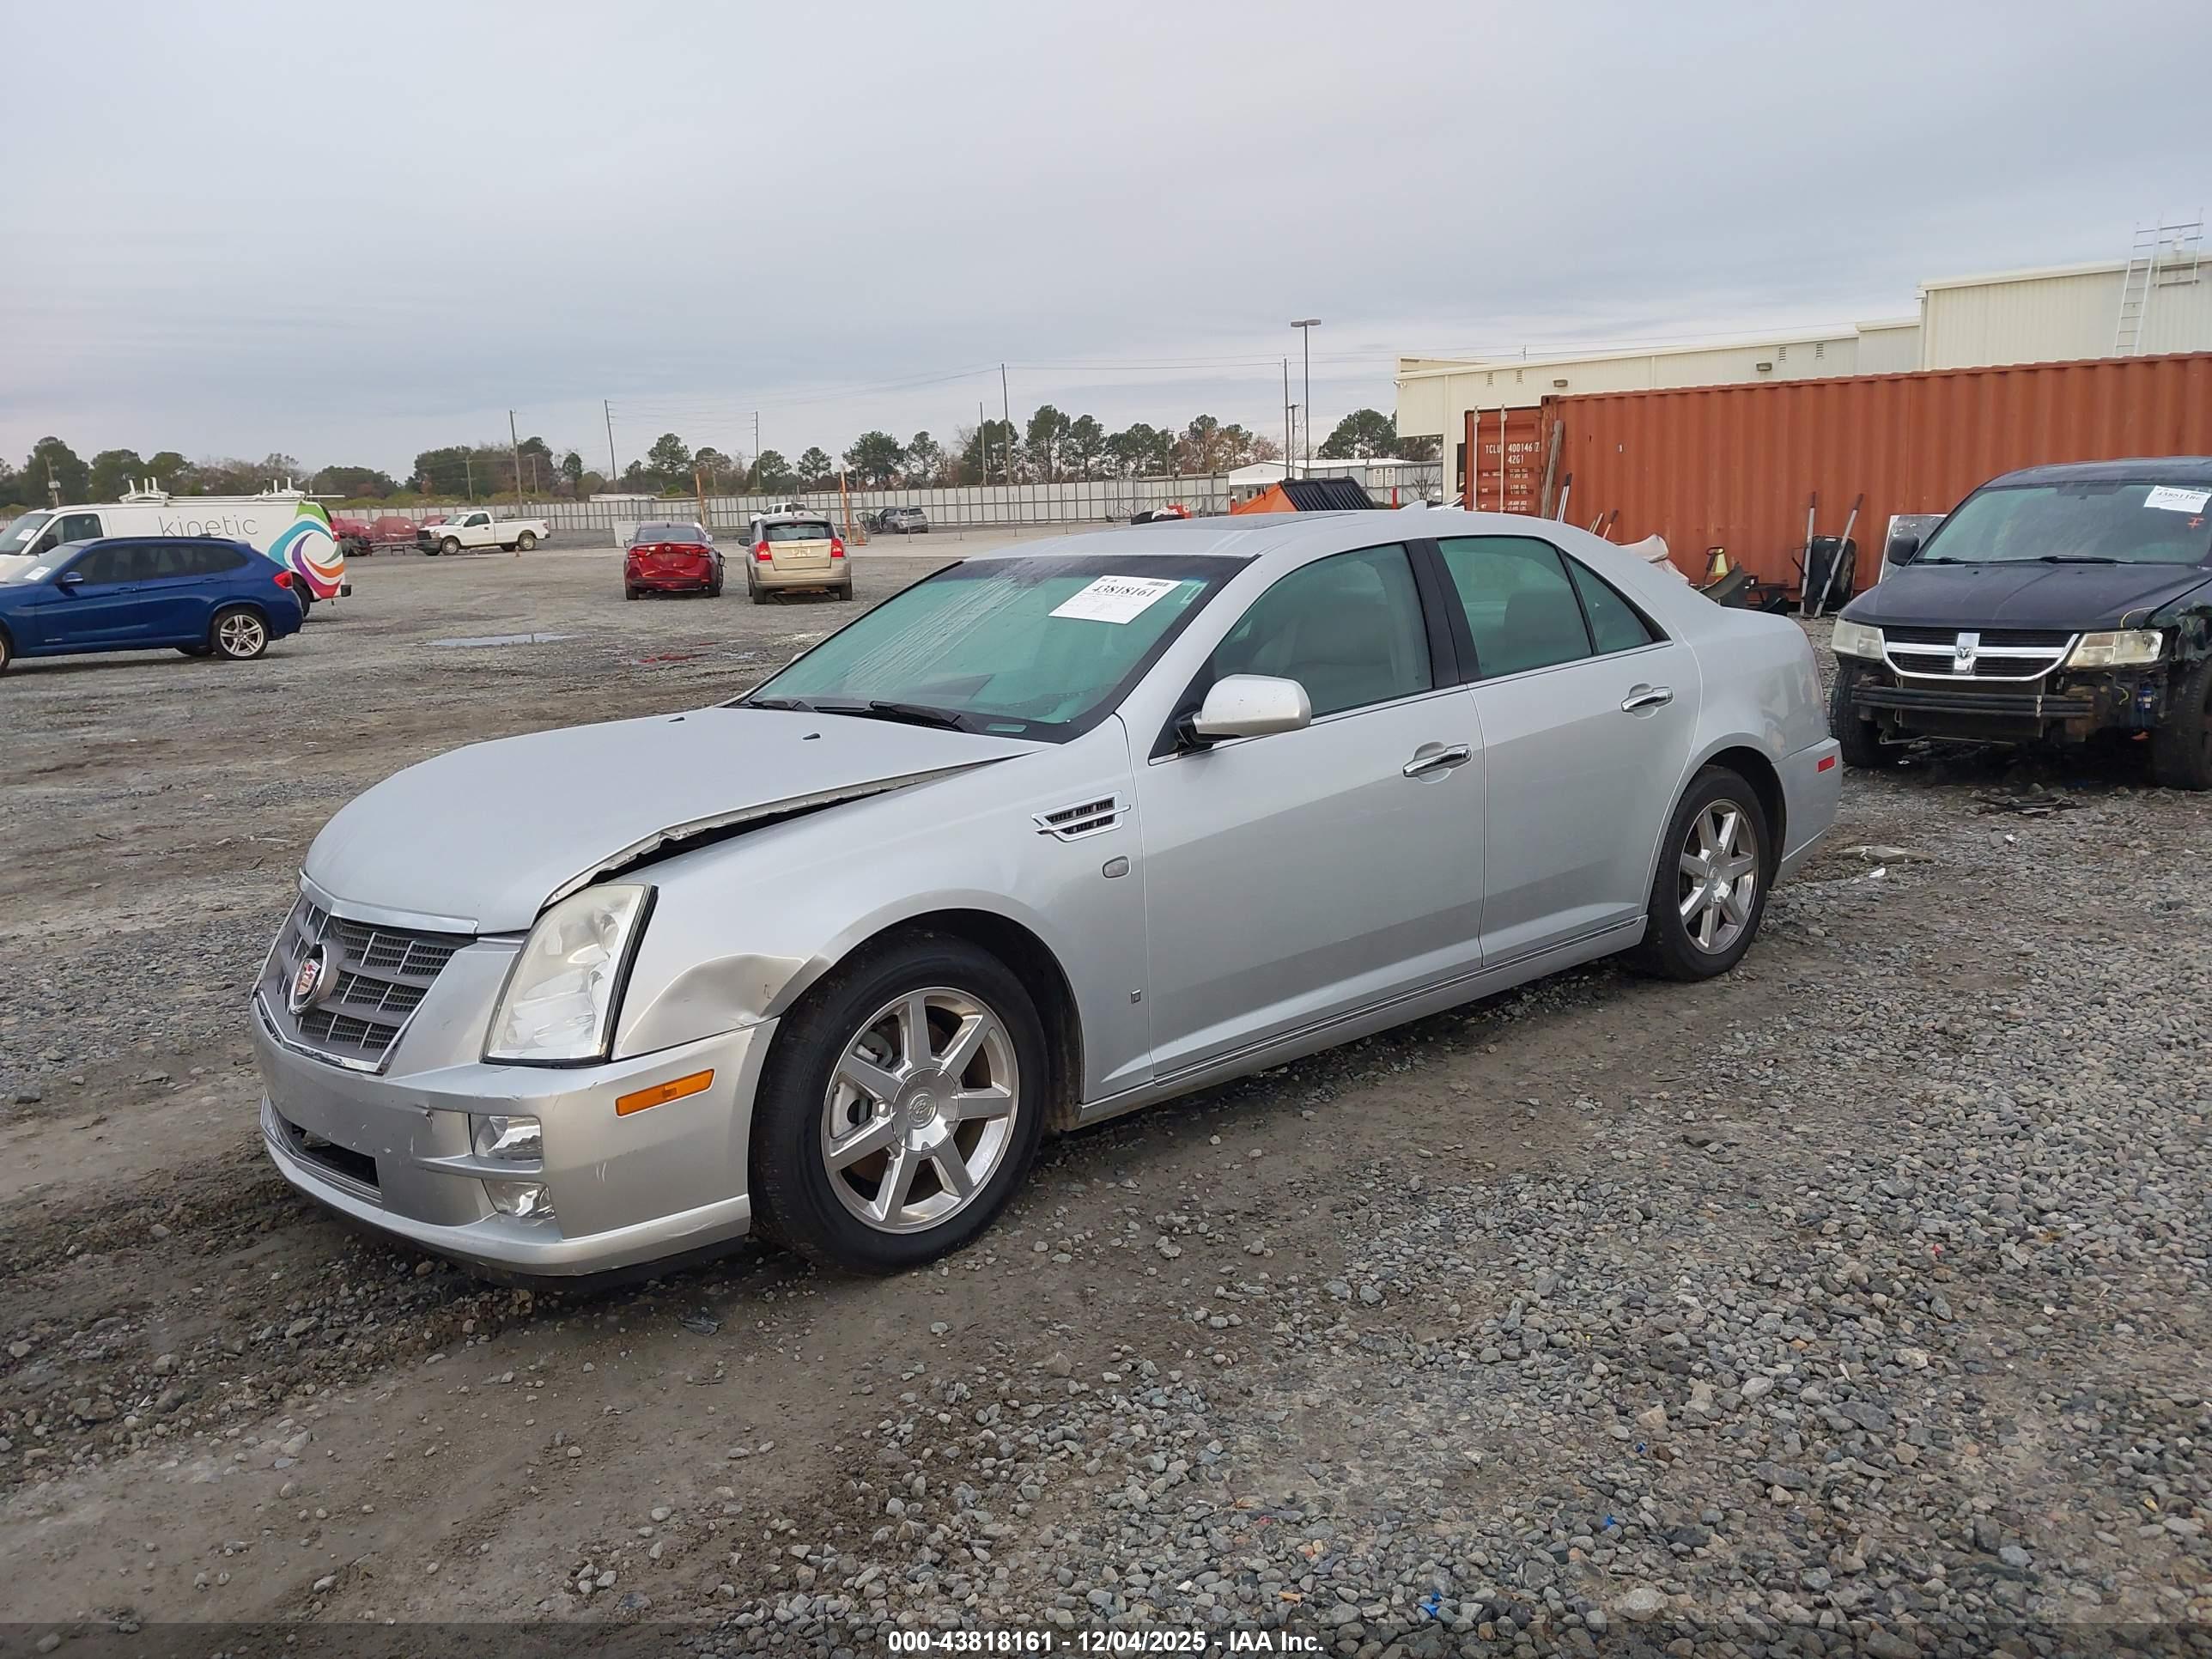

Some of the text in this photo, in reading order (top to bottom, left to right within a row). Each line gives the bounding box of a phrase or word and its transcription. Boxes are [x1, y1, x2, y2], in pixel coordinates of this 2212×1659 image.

[1486, 445, 1502, 454] TCLU
[1508, 442, 1533, 453] 400146
[158, 514, 258, 537] kinetic
[1092, 585, 1157, 597] 43818161
